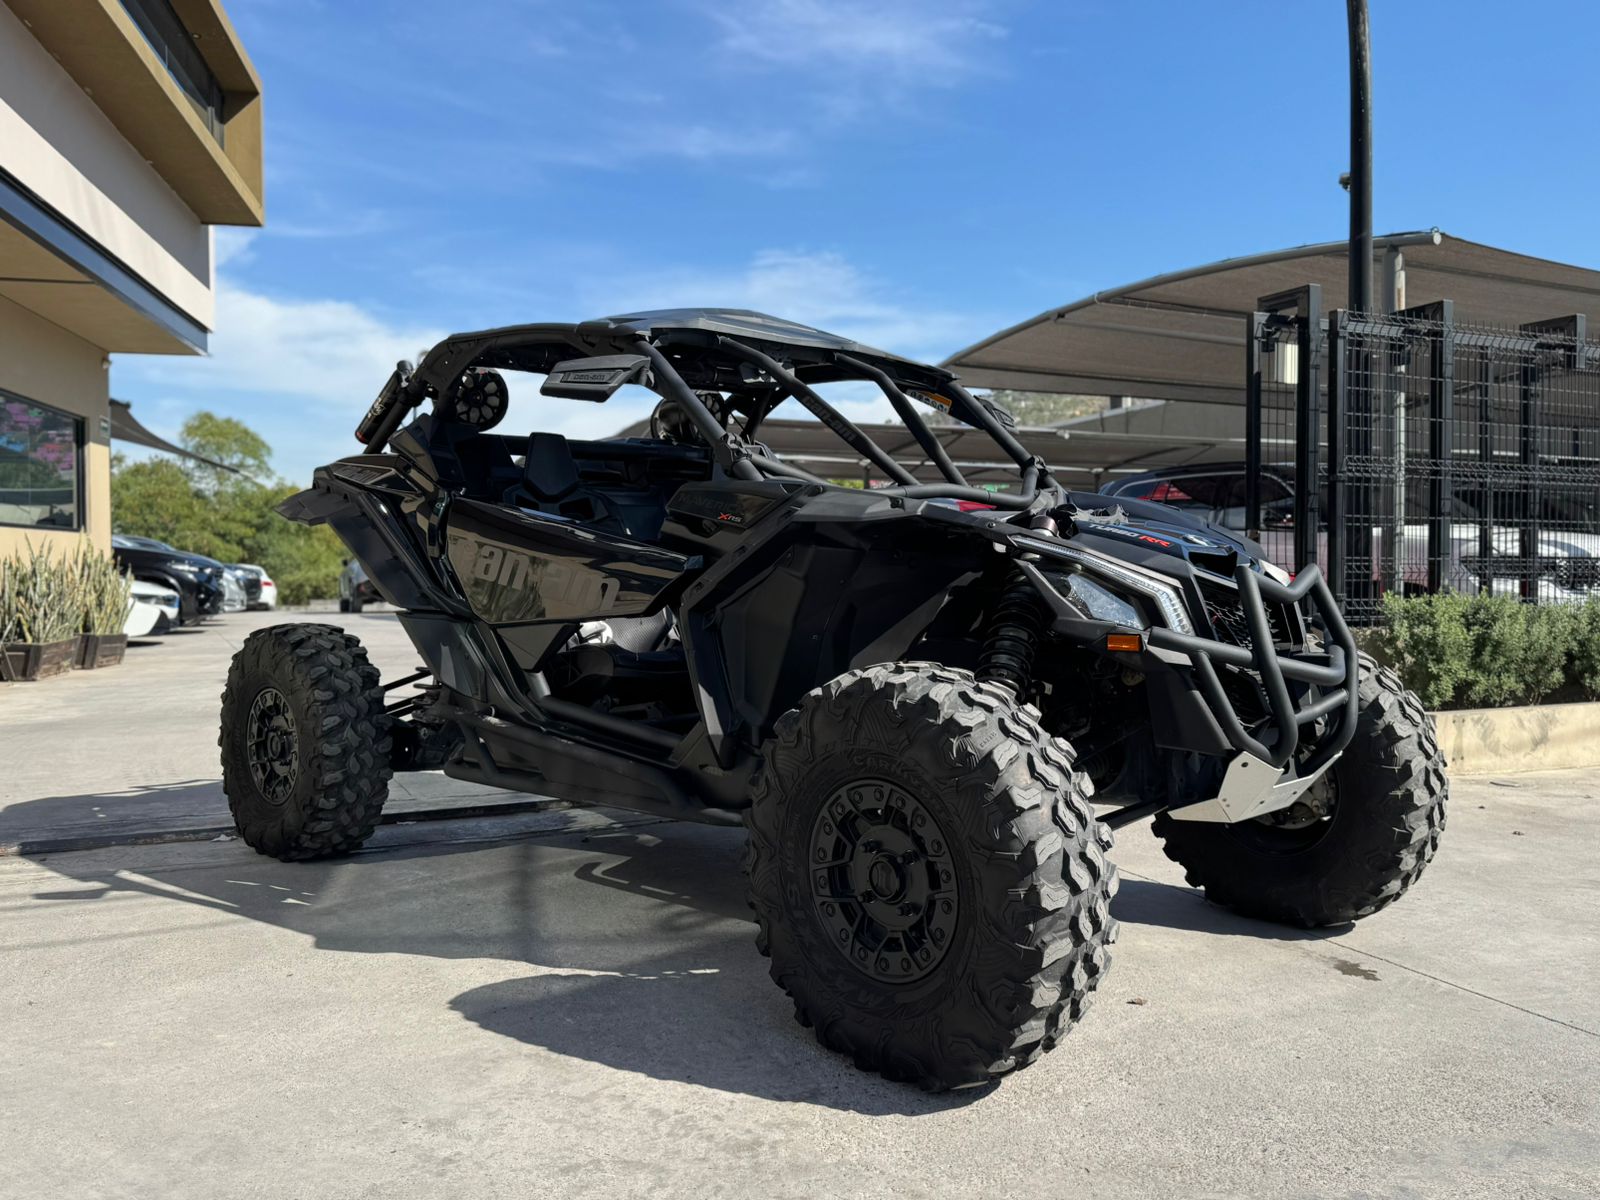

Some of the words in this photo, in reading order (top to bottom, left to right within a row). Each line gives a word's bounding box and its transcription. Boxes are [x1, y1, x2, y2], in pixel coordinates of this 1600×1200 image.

[801, 395, 857, 442] can-am
[671, 492, 743, 515] MAVERIC
[1088, 523, 1140, 538] TURBO
[1138, 535, 1171, 548] RR
